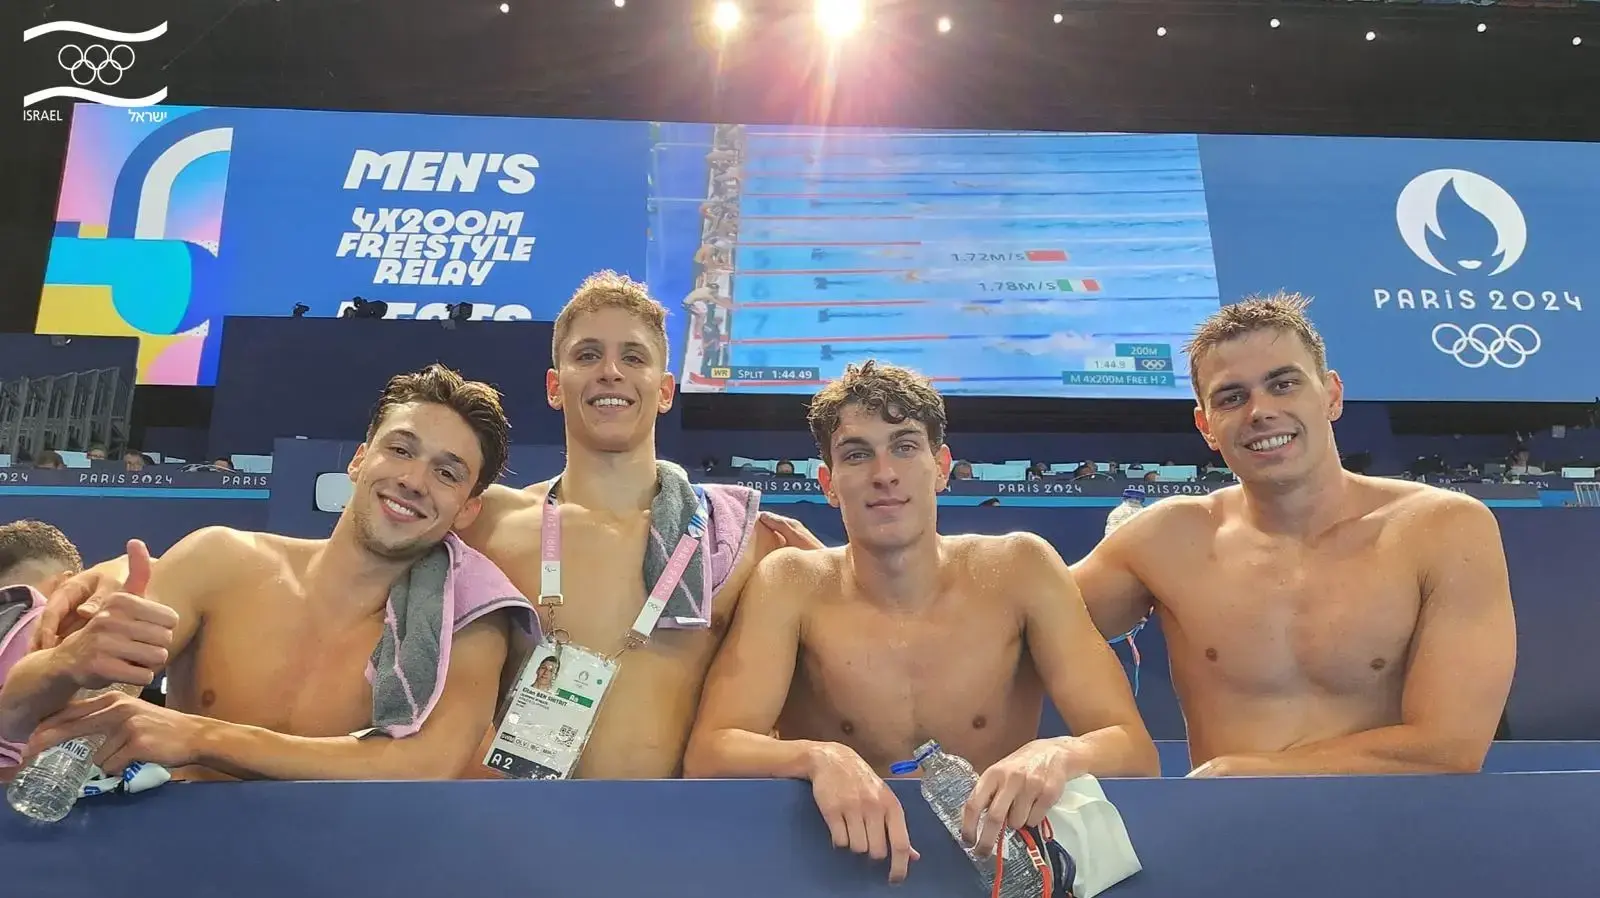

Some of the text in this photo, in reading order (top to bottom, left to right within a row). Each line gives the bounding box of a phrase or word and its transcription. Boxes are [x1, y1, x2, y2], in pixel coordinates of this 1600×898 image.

[343, 149, 540, 194] MEN'S
[352, 207, 524, 236] 4X200M
[336, 232, 536, 262] FREESTYLE
[951, 252, 1025, 262] 1.72M/S
[373, 258, 495, 286] RELAY
[978, 281, 1056, 292] 1.78M/S
[1373, 288, 1583, 312] PARIS 2024
[1130, 346, 1158, 356] 200M
[714, 369, 812, 379] WR SPLIT 1:44.49
[1070, 375, 1080, 384] M
[1150, 376, 1158, 385] H
[1160, 375, 1167, 385] 2
[79, 473, 174, 485] PARIS 2024
[222, 475, 268, 486] PARIS
[998, 483, 1083, 494] PARIS 2024
[1172, 484, 1210, 494] 2024
[491, 753, 513, 769] A 2
